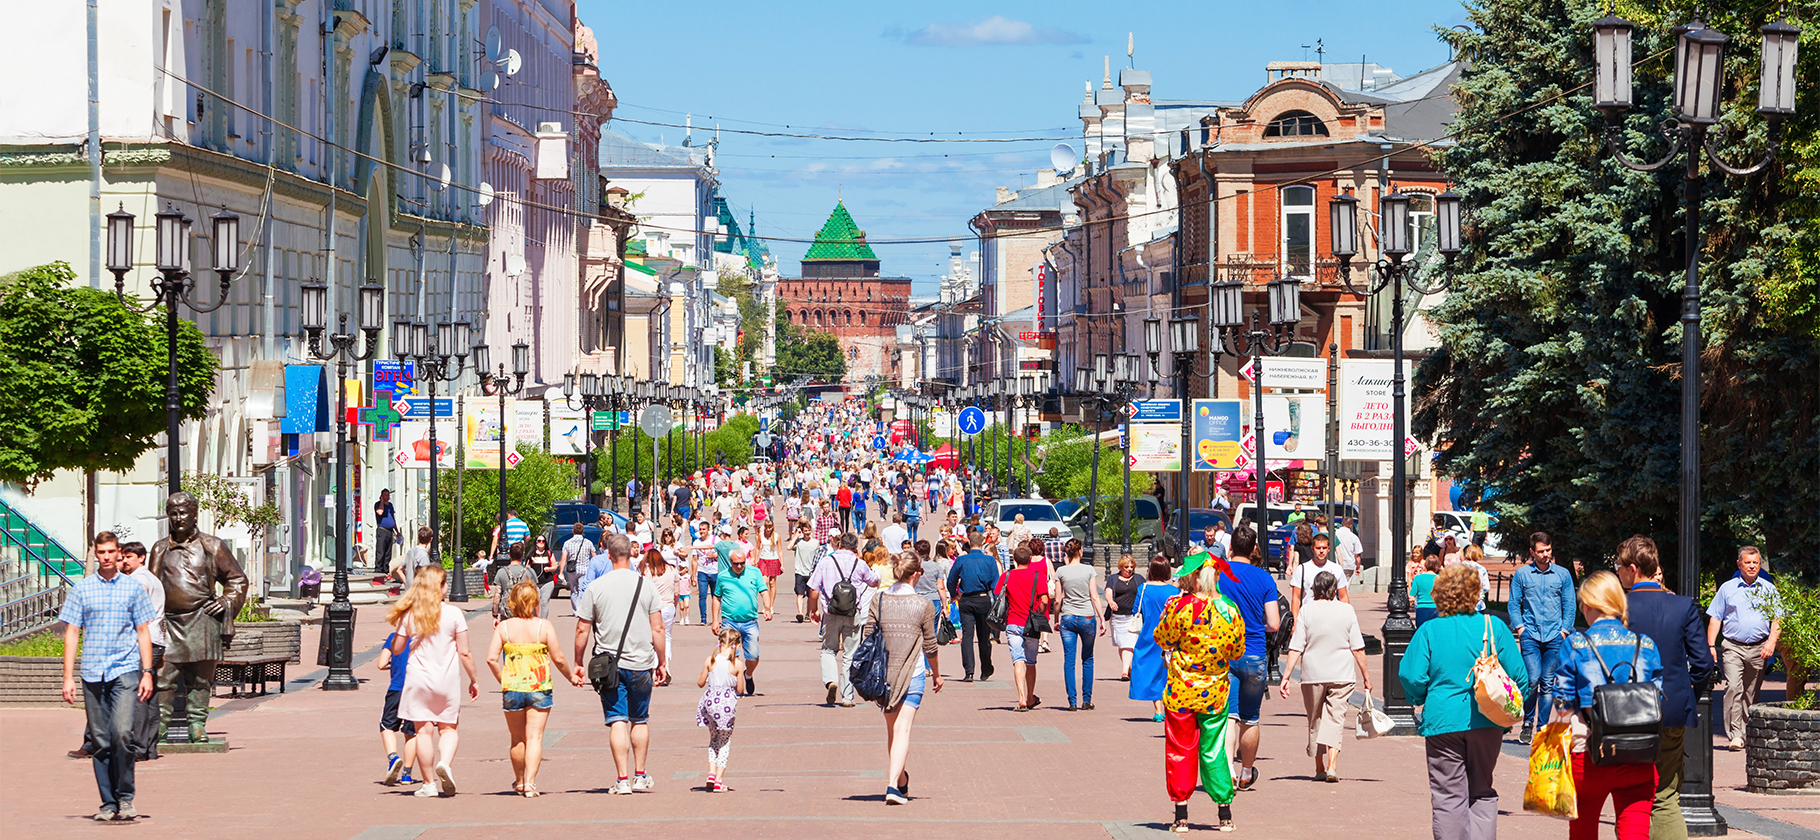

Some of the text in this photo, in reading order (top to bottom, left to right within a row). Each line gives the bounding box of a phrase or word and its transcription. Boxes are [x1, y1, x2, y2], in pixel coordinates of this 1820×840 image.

[1038, 264, 1046, 330] ТОРГОВЫЙ
[1018, 332, 1056, 340] ЦЕНТР
[374, 370, 414, 382] ЭГНА
